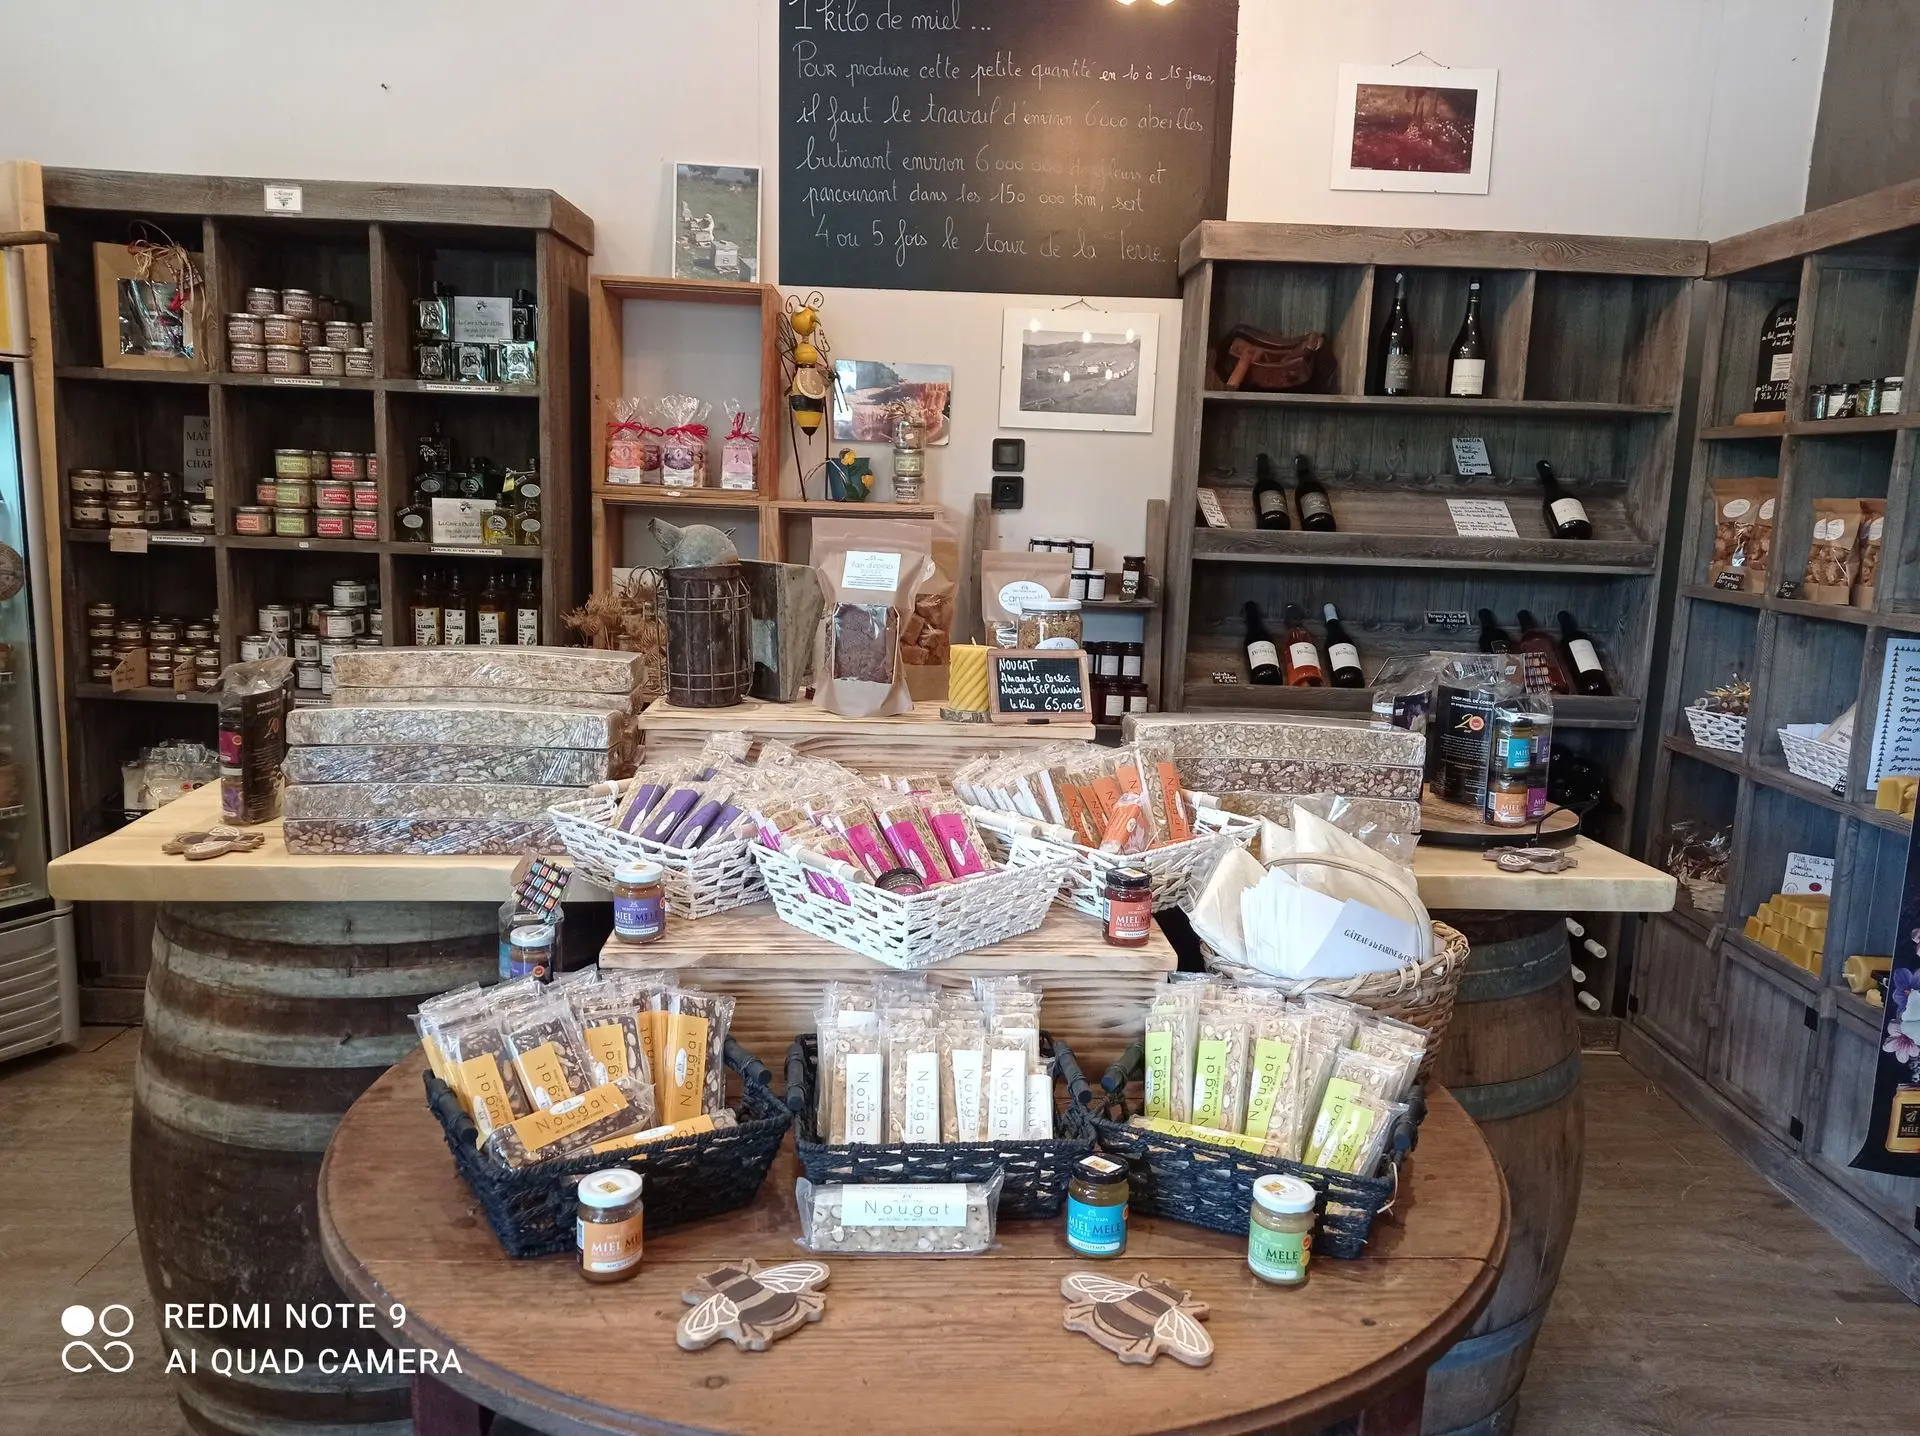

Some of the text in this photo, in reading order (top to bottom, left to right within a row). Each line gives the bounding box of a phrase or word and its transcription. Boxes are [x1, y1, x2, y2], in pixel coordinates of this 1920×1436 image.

[876, 0, 903, 30] de
[911, 0, 961, 30] miel
[919, 53, 960, 79] cette
[970, 50, 1022, 97] petite
[1099, 68, 1117, 82] en
[1122, 63, 1140, 81] 10
[1145, 64, 1153, 81] à
[796, 92, 820, 124] il
[826, 95, 873, 142] faut
[883, 94, 912, 124] le
[920, 92, 1001, 125] travail
[1137, 102, 1204, 132] abeilles
[795, 134, 893, 171] butinant
[902, 151, 967, 172] environ
[975, 143, 990, 172] 6
[1149, 161, 1168, 184] et
[802, 178, 898, 217] parcourant
[909, 182, 949, 202] dans
[955, 183, 981, 203] les
[815, 213, 830, 248] 4
[836, 231, 860, 248] ou
[872, 218, 885, 247] 5
[894, 218, 928, 268] fois
[942, 215, 960, 249] le
[974, 222, 1029, 254] tour
[1072, 227, 1098, 259] la
[999, 658, 1037, 671] NOUGAT
[1000, 672, 1041, 684] Amandes
[1115, 915, 1140, 924] MIEL
[1344, 928, 1370, 945] GÂTEAU
[1377, 944, 1399, 958] FARINE
[680, 1031, 698, 1108] Nougat
[1248, 1055, 1277, 1121] Nougat
[536, 1091, 609, 1134] Nougat
[1168, 1124, 1246, 1148] Nougat
[864, 1200, 950, 1217] Nougat
[1069, 1215, 1091, 1232] MIEL
[1093, 1223, 1120, 1234] MELE
[591, 1241, 621, 1252] MIEL
[1265, 1249, 1299, 1260] MELE
